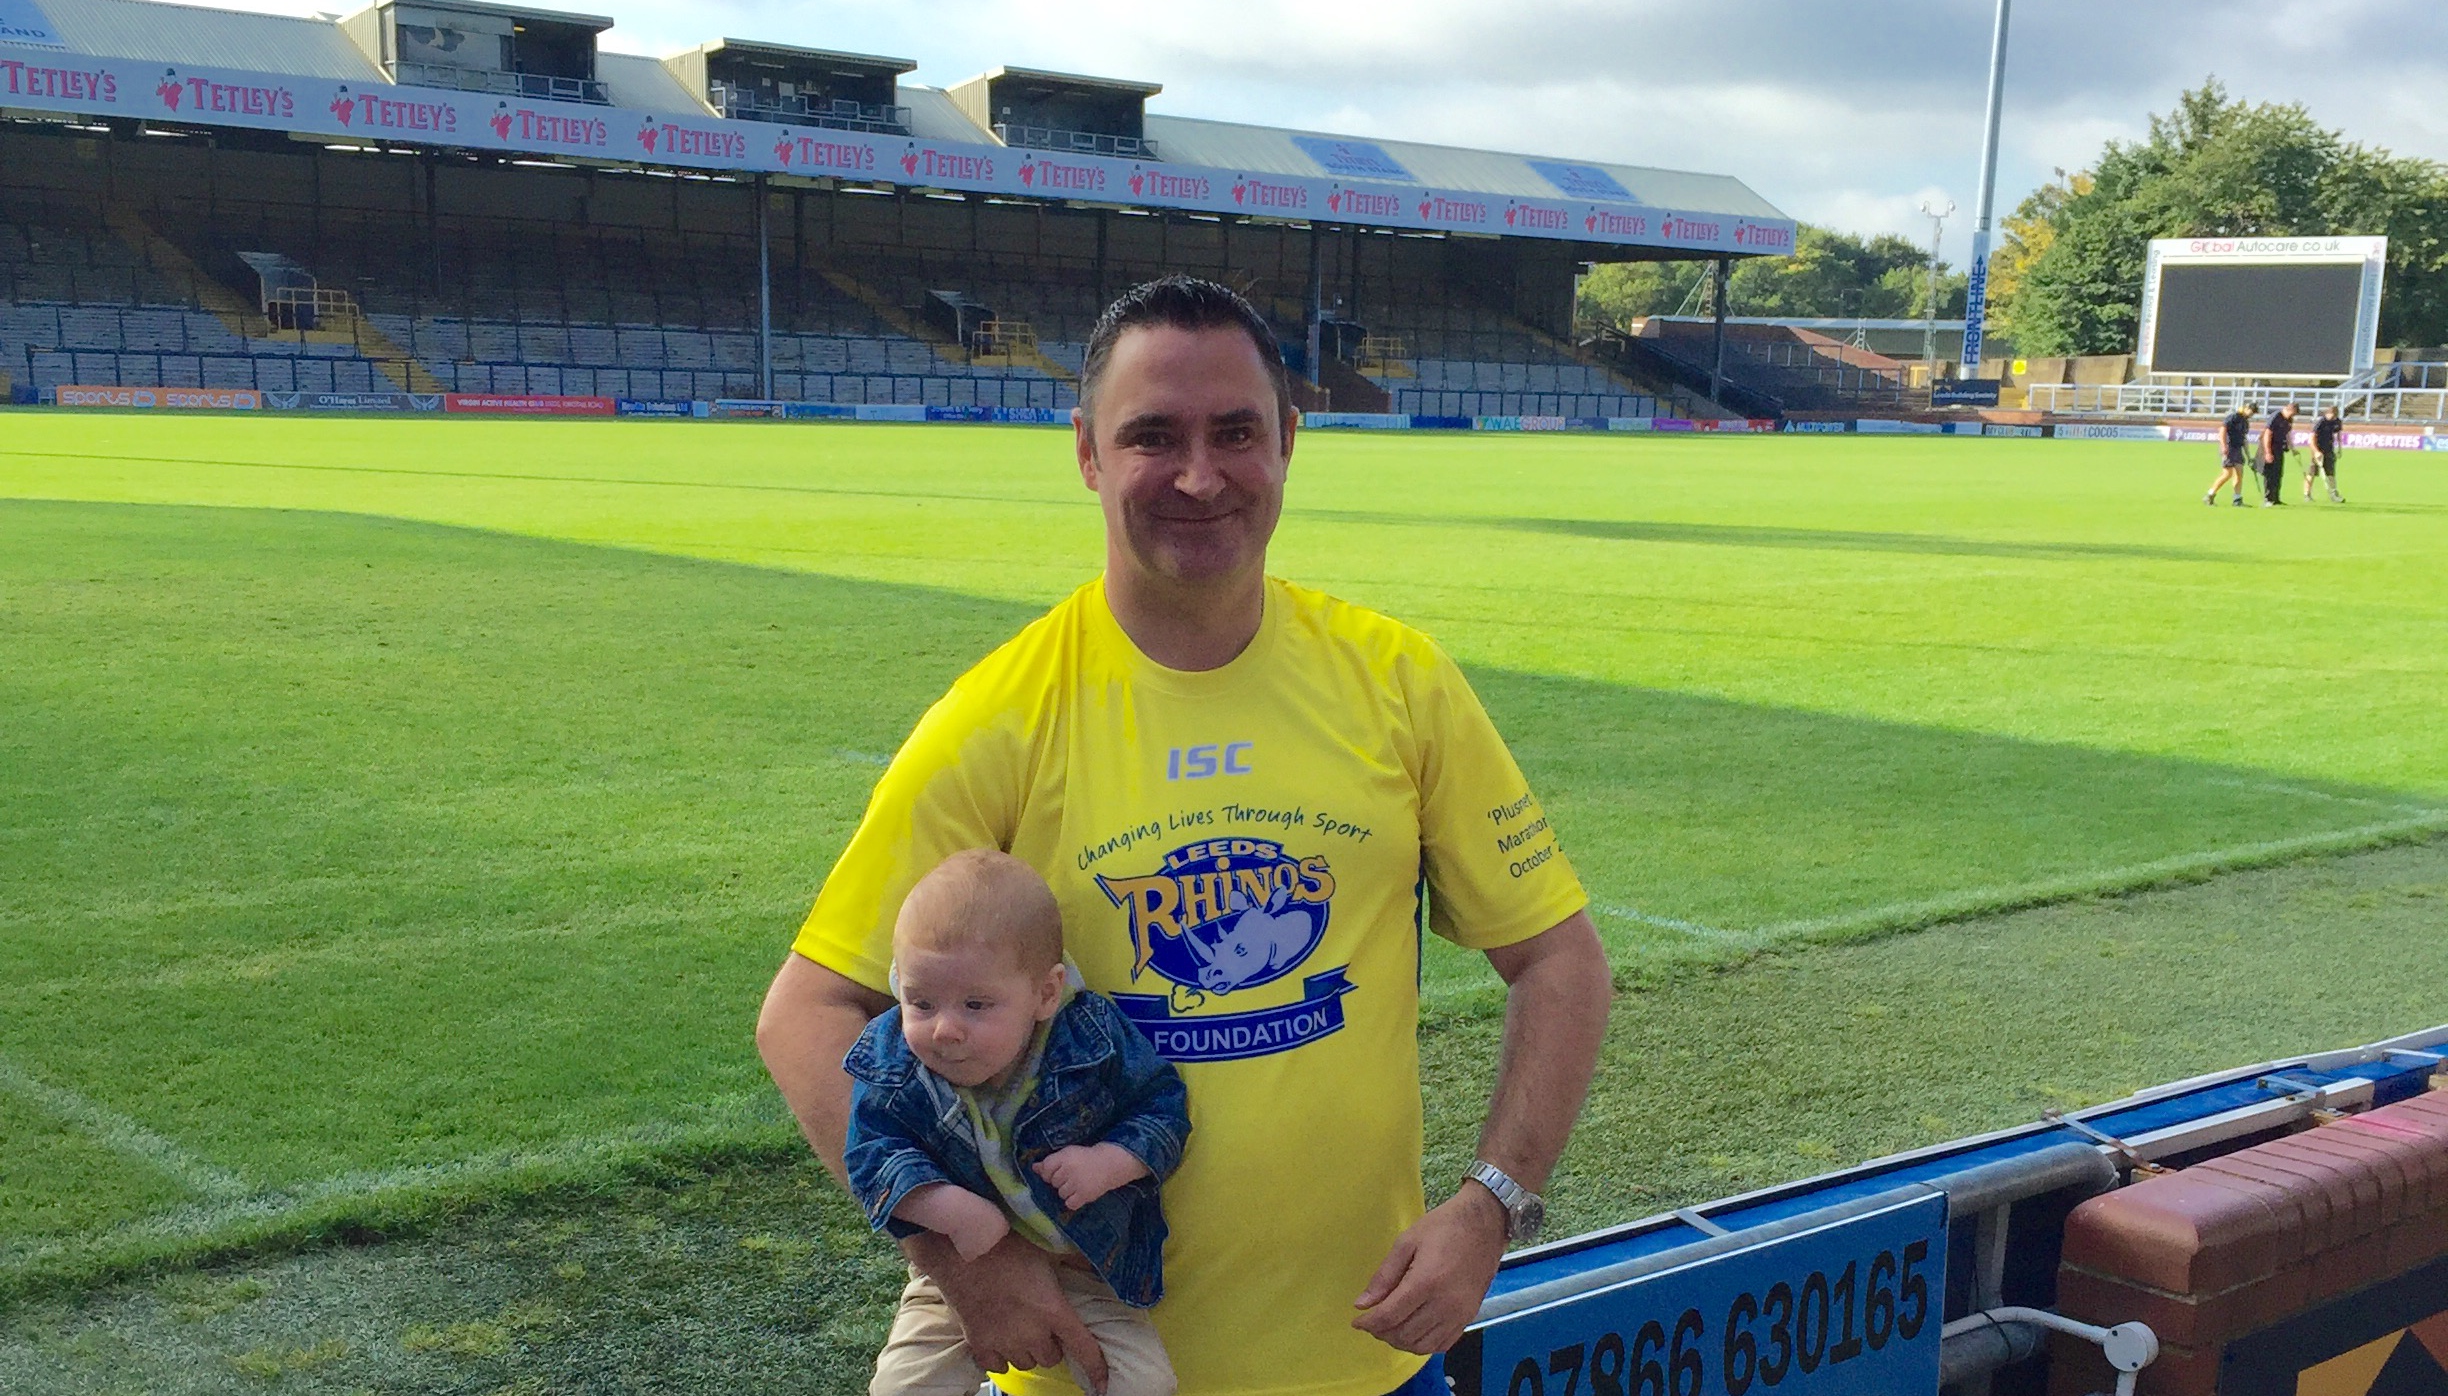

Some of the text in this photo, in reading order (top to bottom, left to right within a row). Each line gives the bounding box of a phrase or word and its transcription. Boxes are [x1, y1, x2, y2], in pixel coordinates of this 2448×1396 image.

[0, 60, 117, 102] TETLEY'S
[187, 77, 294, 118] TETLEY'S
[358, 93, 457, 133] TETLEY'S
[516, 109, 607, 146] TETLEY'S
[662, 122, 745, 160] TETLEY'S
[797, 135, 875, 171] TETLEY'S
[922, 149, 994, 181] TETLEY'S
[1038, 160, 1105, 192] TETLEY'S
[1147, 170, 1209, 199] TETLEY'S
[1248, 180, 1307, 209] TETLEY'S
[1342, 189, 1399, 218] TETLEY'S
[1434, 197, 1486, 225] TETLEY'S
[1518, 204, 1569, 230] TETLEY'S
[1600, 211, 1646, 236] TETLEY'S
[1675, 217, 1719, 242] TETLEY'S
[1747, 226, 1789, 248] TETLEY'S
[1964, 266, 1987, 365] FRONTLINE
[2347, 434, 2421, 448] PROPERTIES
[1166, 740, 1253, 781] ISC
[1078, 803, 1373, 870] Changing Lives Through Sport
[1167, 840, 1278, 870] LEEDS
[1509, 845, 1553, 878] October
[1153, 1008, 1328, 1052] FOUNDATION
[1723, 1240, 1928, 1396] 630165
